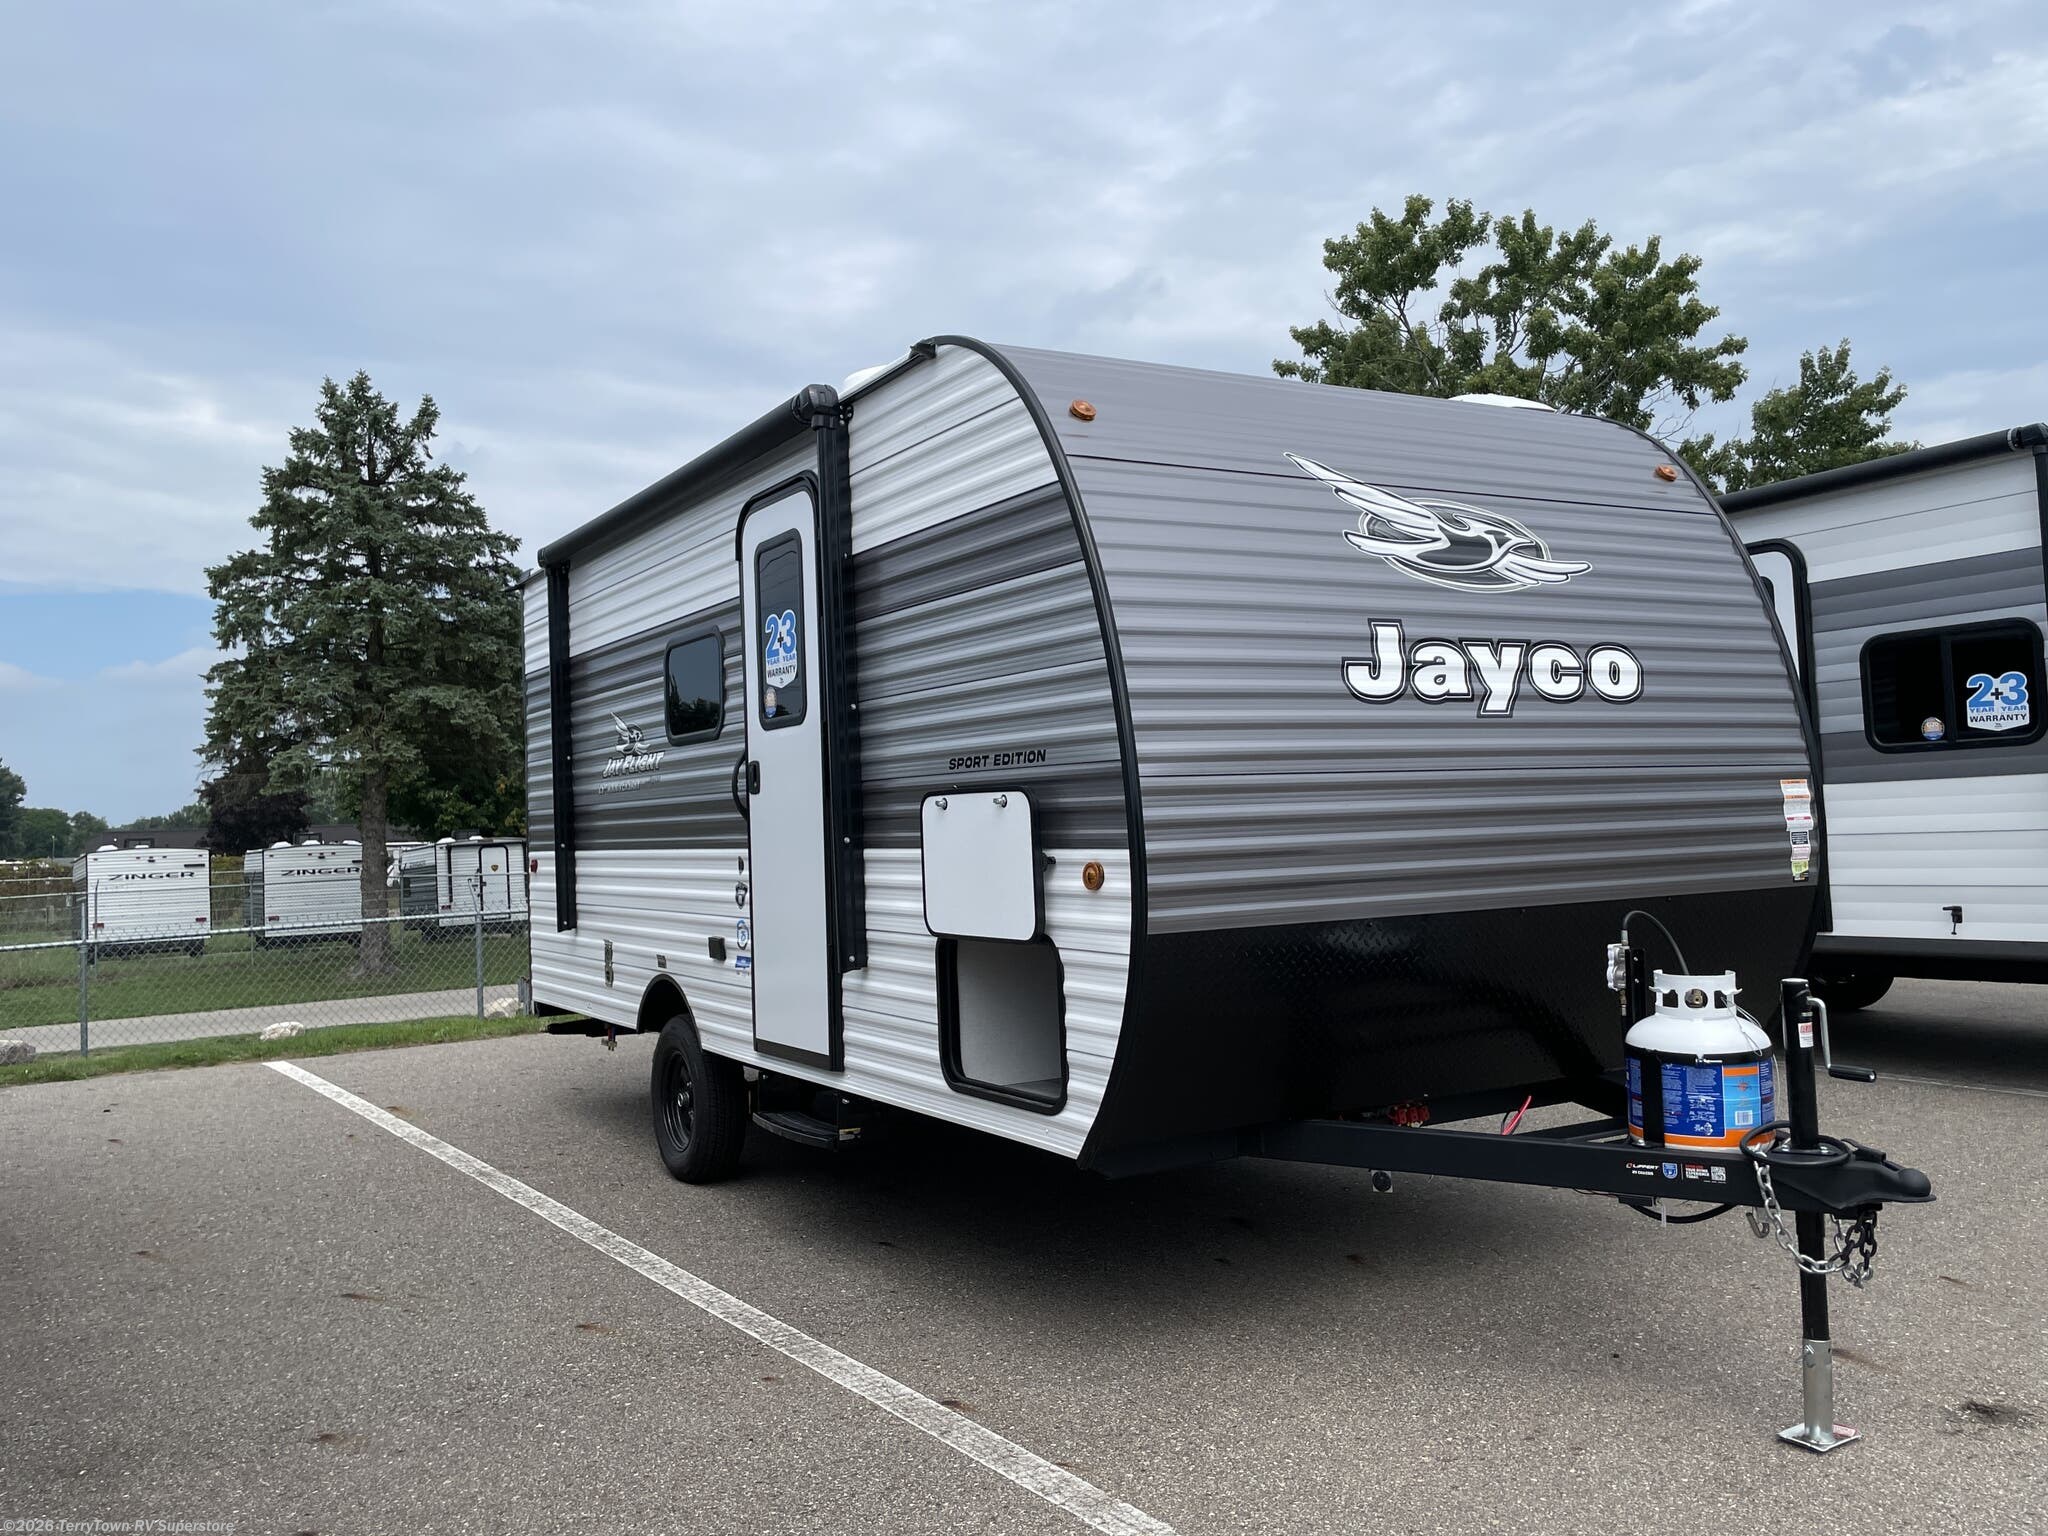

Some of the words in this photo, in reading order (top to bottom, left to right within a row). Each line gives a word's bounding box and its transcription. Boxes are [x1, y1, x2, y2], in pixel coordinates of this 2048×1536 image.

[767, 664, 796, 679] WARRANTY
[1341, 618, 1644, 718] Jayco
[1969, 713, 2027, 722] WARRANTY
[949, 754, 990, 770] SPORT
[993, 749, 1047, 766] EDITION
[108, 871, 195, 881] ZINGER
[281, 866, 360, 877] ZINGER
